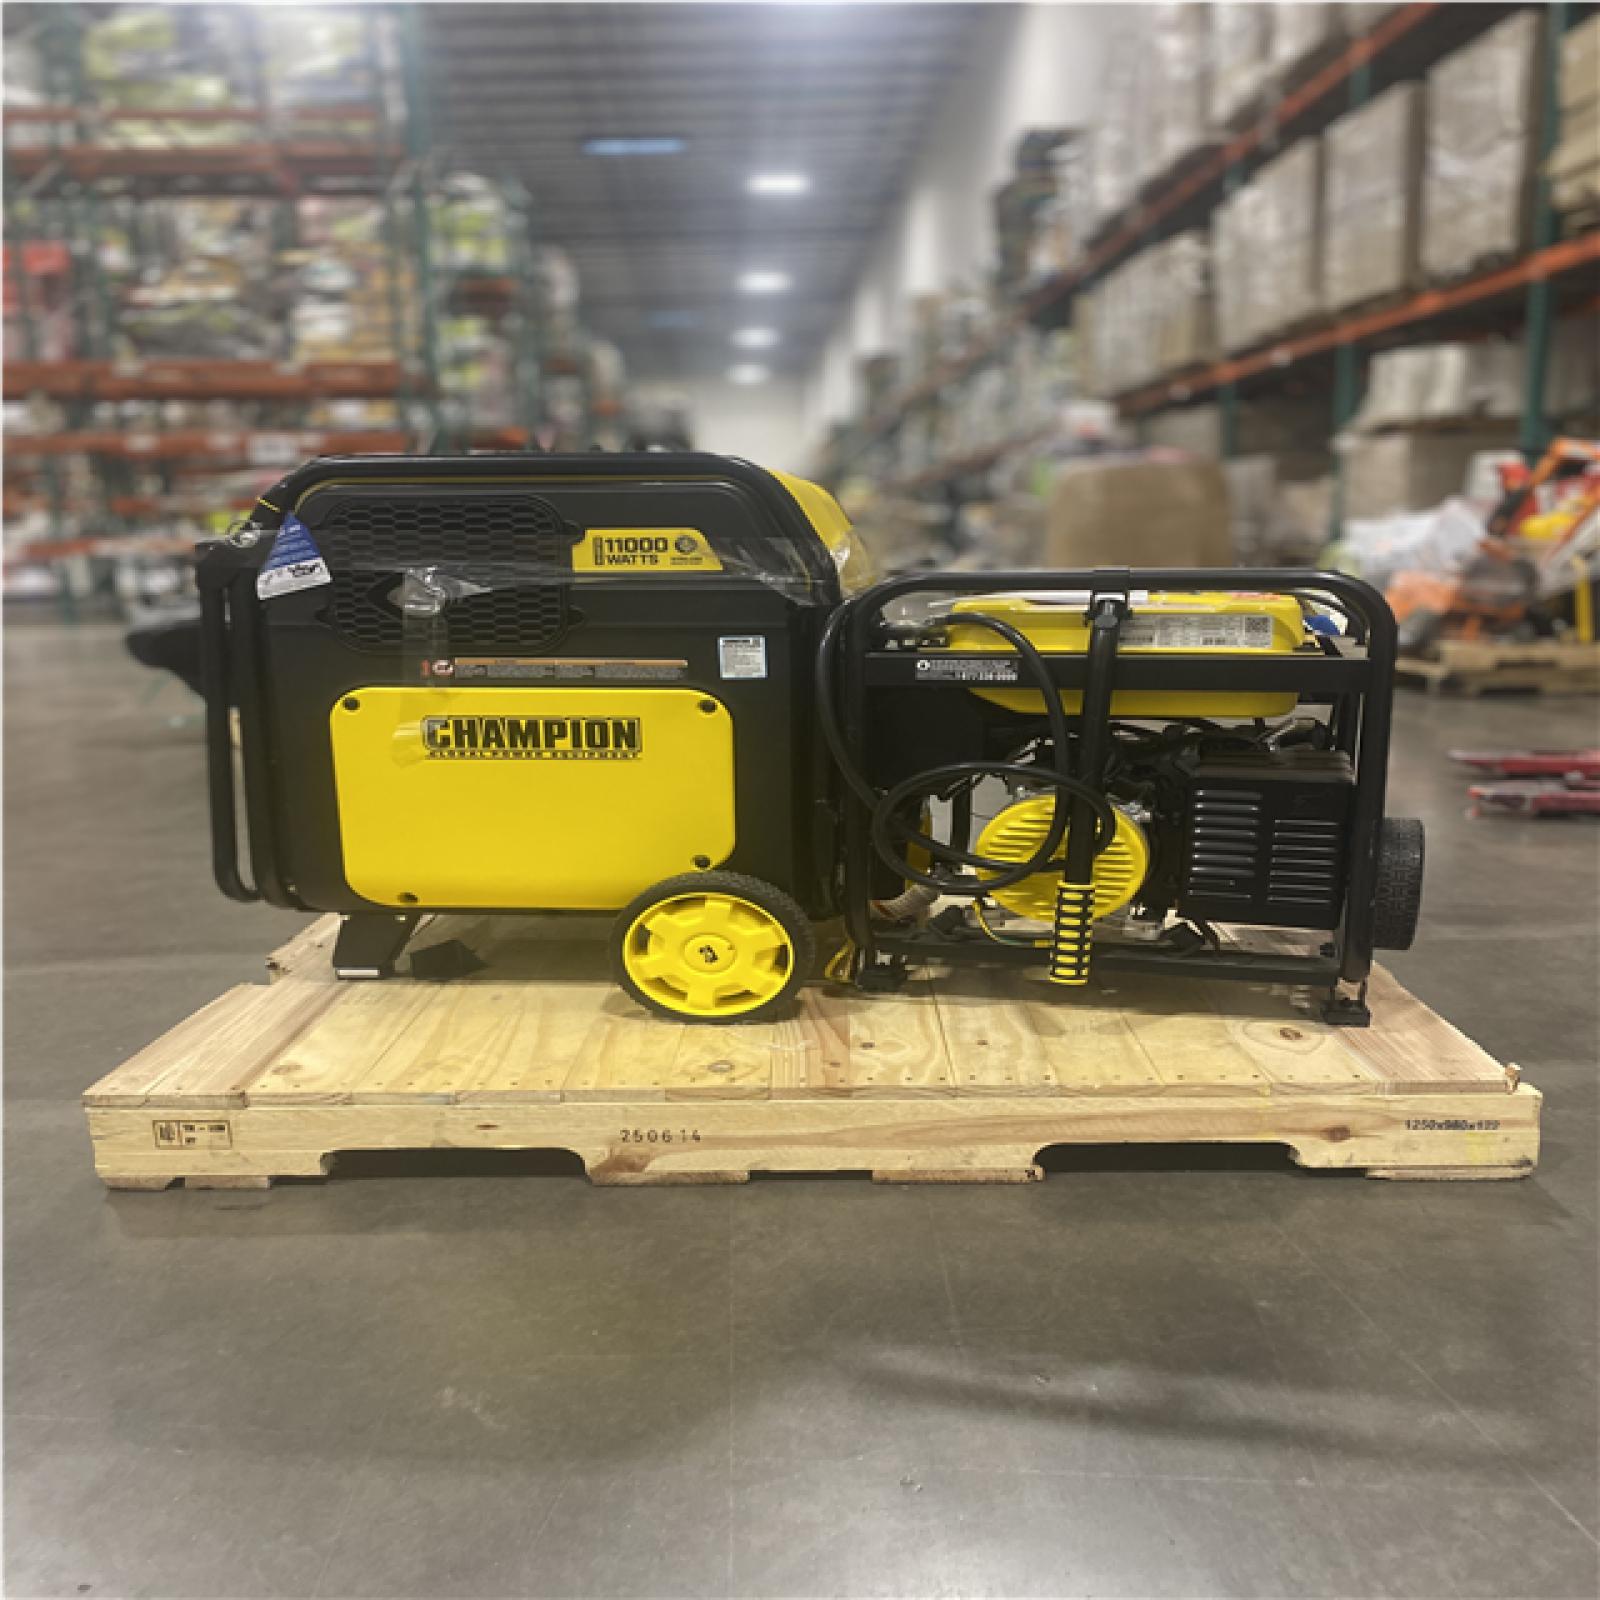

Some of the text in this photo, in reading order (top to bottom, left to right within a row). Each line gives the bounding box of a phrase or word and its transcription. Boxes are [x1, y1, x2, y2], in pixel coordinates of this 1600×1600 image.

[605, 537, 668, 553] 11000
[606, 554, 660, 566] WATTS
[425, 717, 640, 750] CHAMPION
[428, 750, 641, 759] GLOBAL POWER EQUIPMENT
